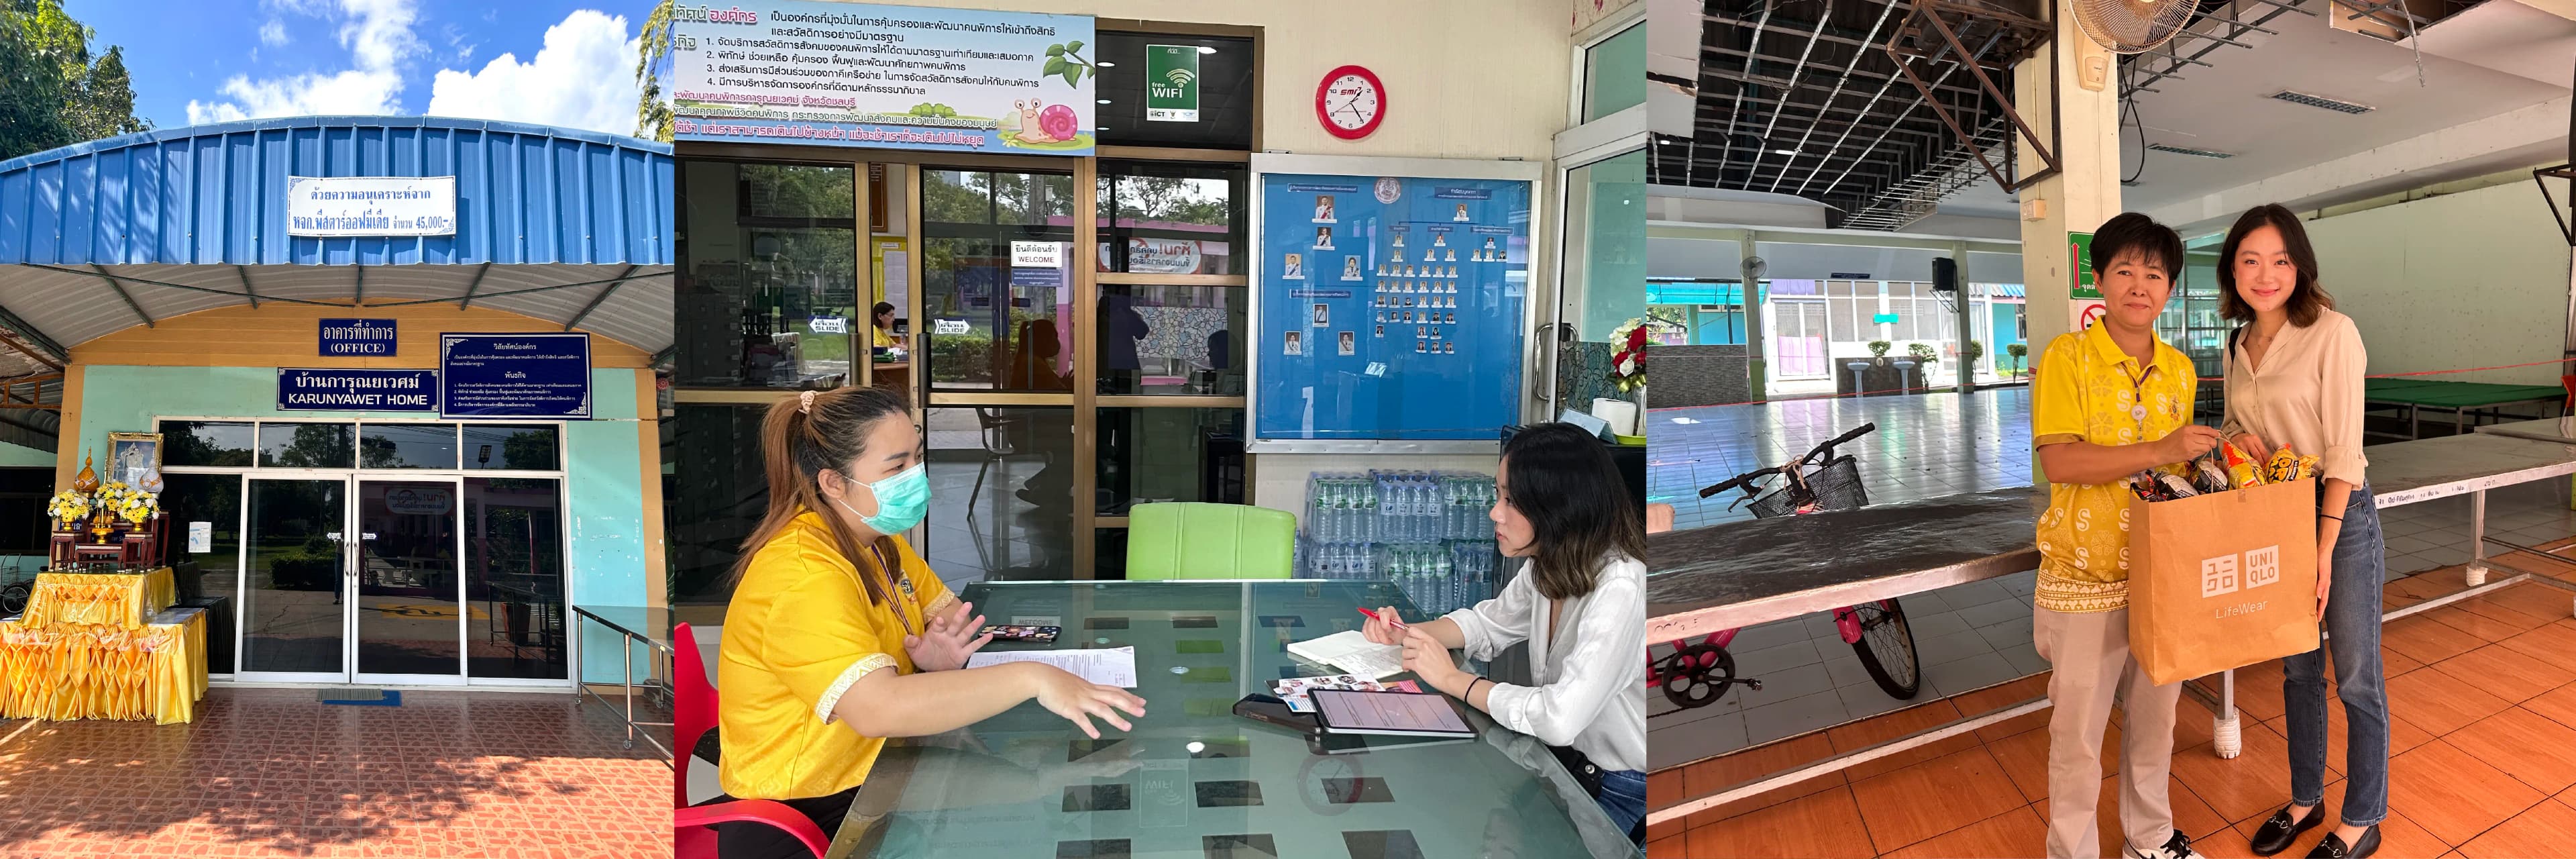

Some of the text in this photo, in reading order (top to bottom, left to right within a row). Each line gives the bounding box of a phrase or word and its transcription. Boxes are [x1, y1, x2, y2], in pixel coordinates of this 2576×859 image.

[710, 7, 757, 23] องค์กร
[771, 28, 904, 44] และสวัสดิการอย่างมีมาตรฐาน
[706, 51, 714, 59] 2.
[718, 51, 745, 61] พิทักษ์
[749, 52, 788, 62] ช่วยเหลือ
[792, 54, 828, 65] คุ้มครอง
[707, 64, 714, 72] 3.
[708, 78, 715, 86] 4.
[1152, 88, 1183, 99] WIFI
[802, 95, 856, 109] จังหวัดชลบุรี
[311, 185, 431, 205] ด้วยความอนุเคราะห์จาก
[1015, 244, 1058, 253] ยินดีต้อนรับ
[323, 319, 393, 340] อาคารที่ทำการ
[331, 343, 385, 354] (OFFICE)
[504, 370, 526, 378] พันธกิจ
[296, 372, 421, 393] บ้านการุณยเวศม์
[288, 394, 427, 405] KARUNYAWET HOME
[2250, 551, 2273, 568] UNI
[2250, 566, 2275, 585] QLO
[2216, 601, 2268, 619] LifeWear
